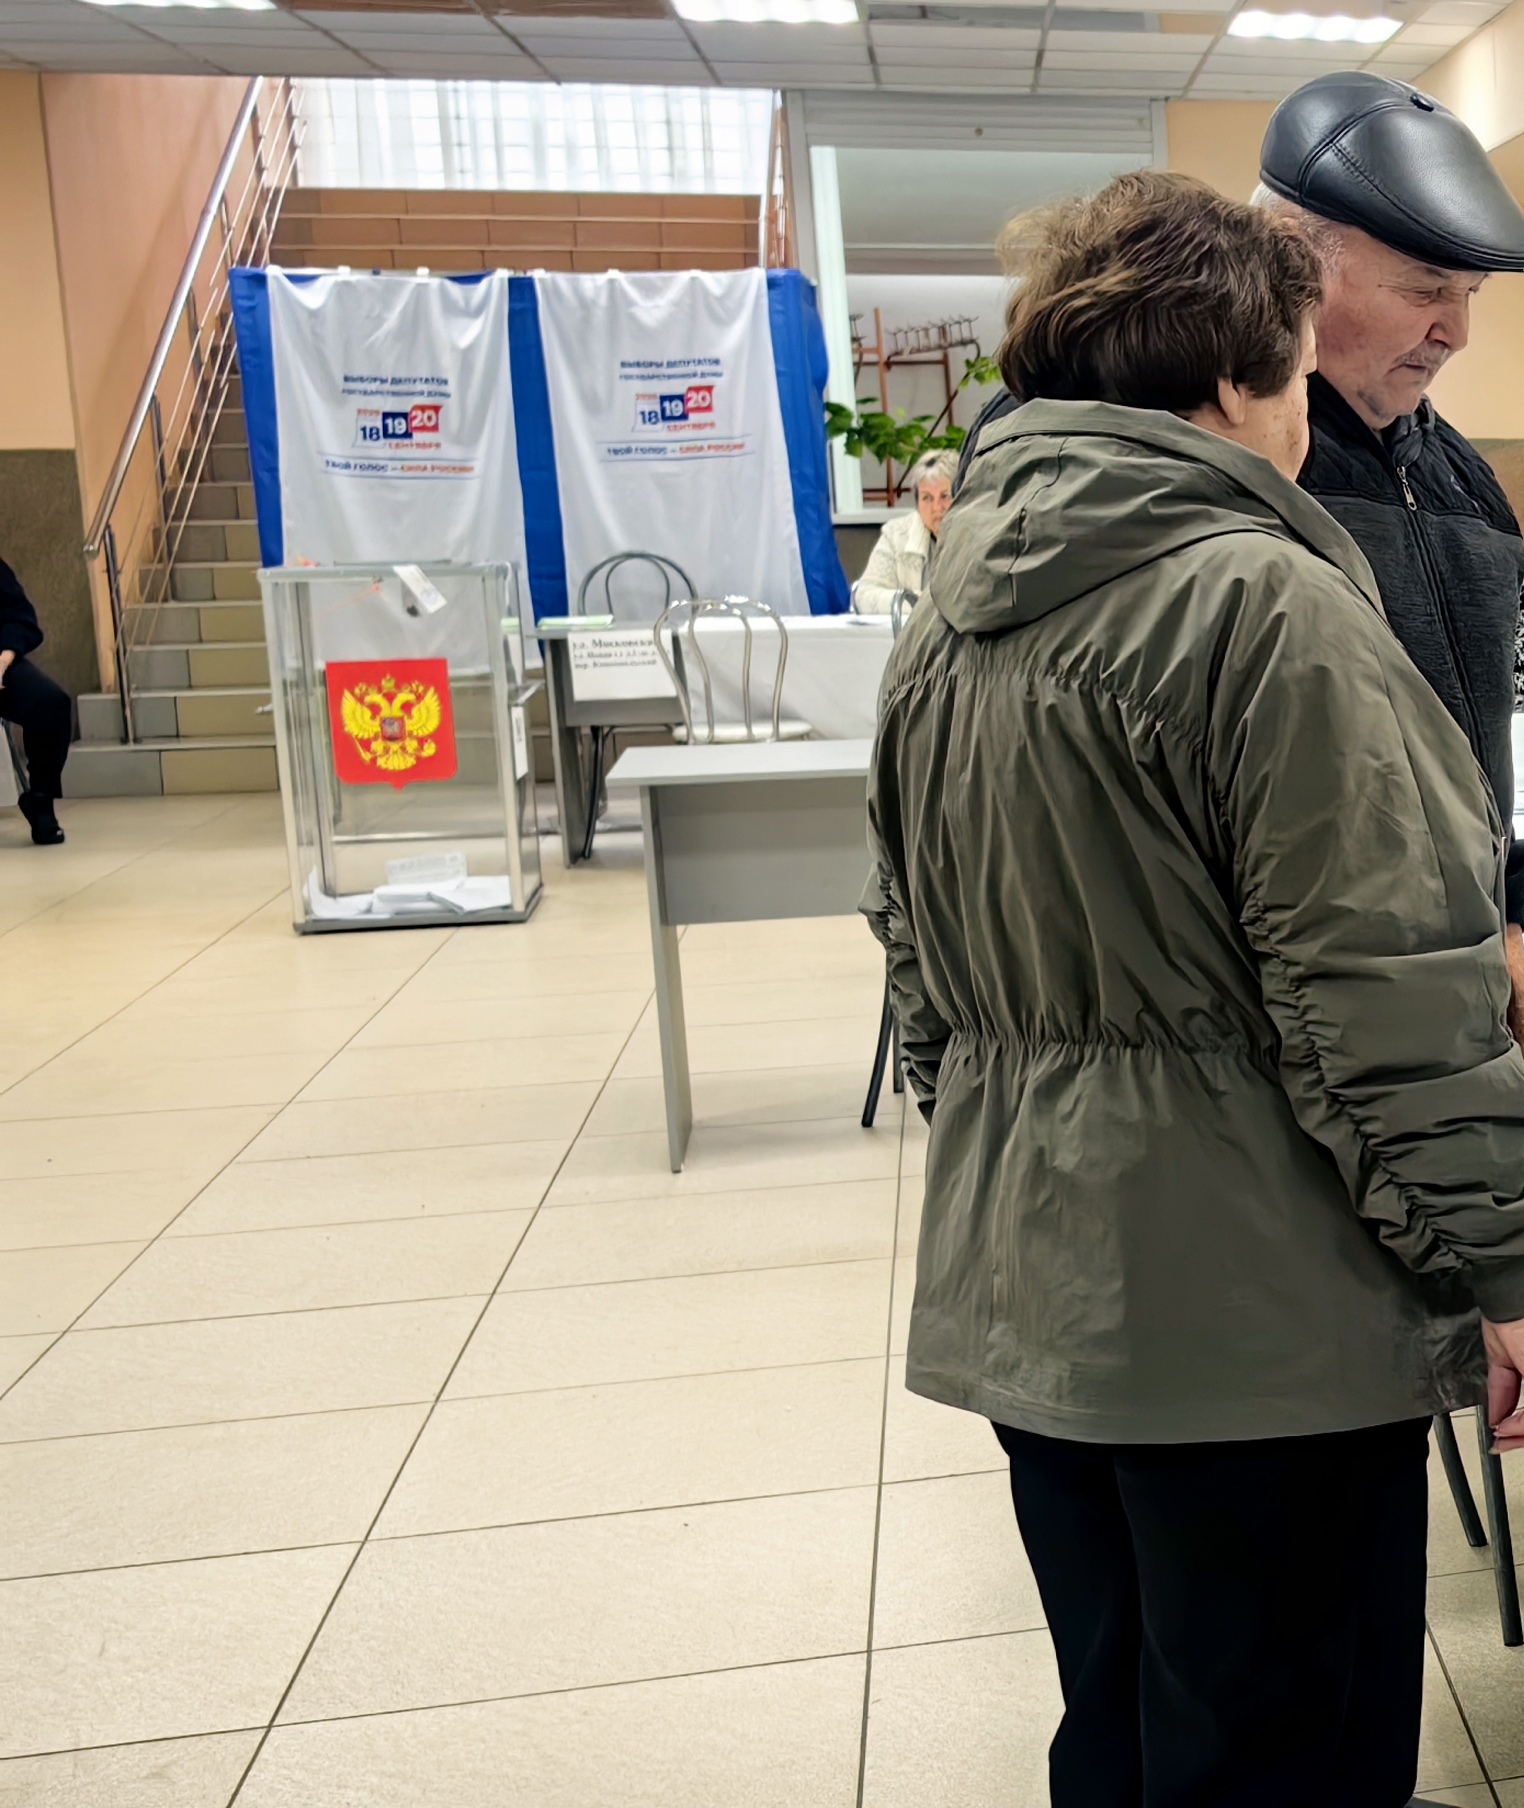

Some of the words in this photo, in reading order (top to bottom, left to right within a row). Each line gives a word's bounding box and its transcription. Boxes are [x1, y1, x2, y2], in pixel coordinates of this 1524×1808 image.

[639, 410, 660, 425] 18
[662, 399, 684, 417] 19
[687, 390, 711, 408] 20
[360, 426, 381, 441] 18
[384, 416, 407, 435] 19
[411, 409, 436, 428] 20
